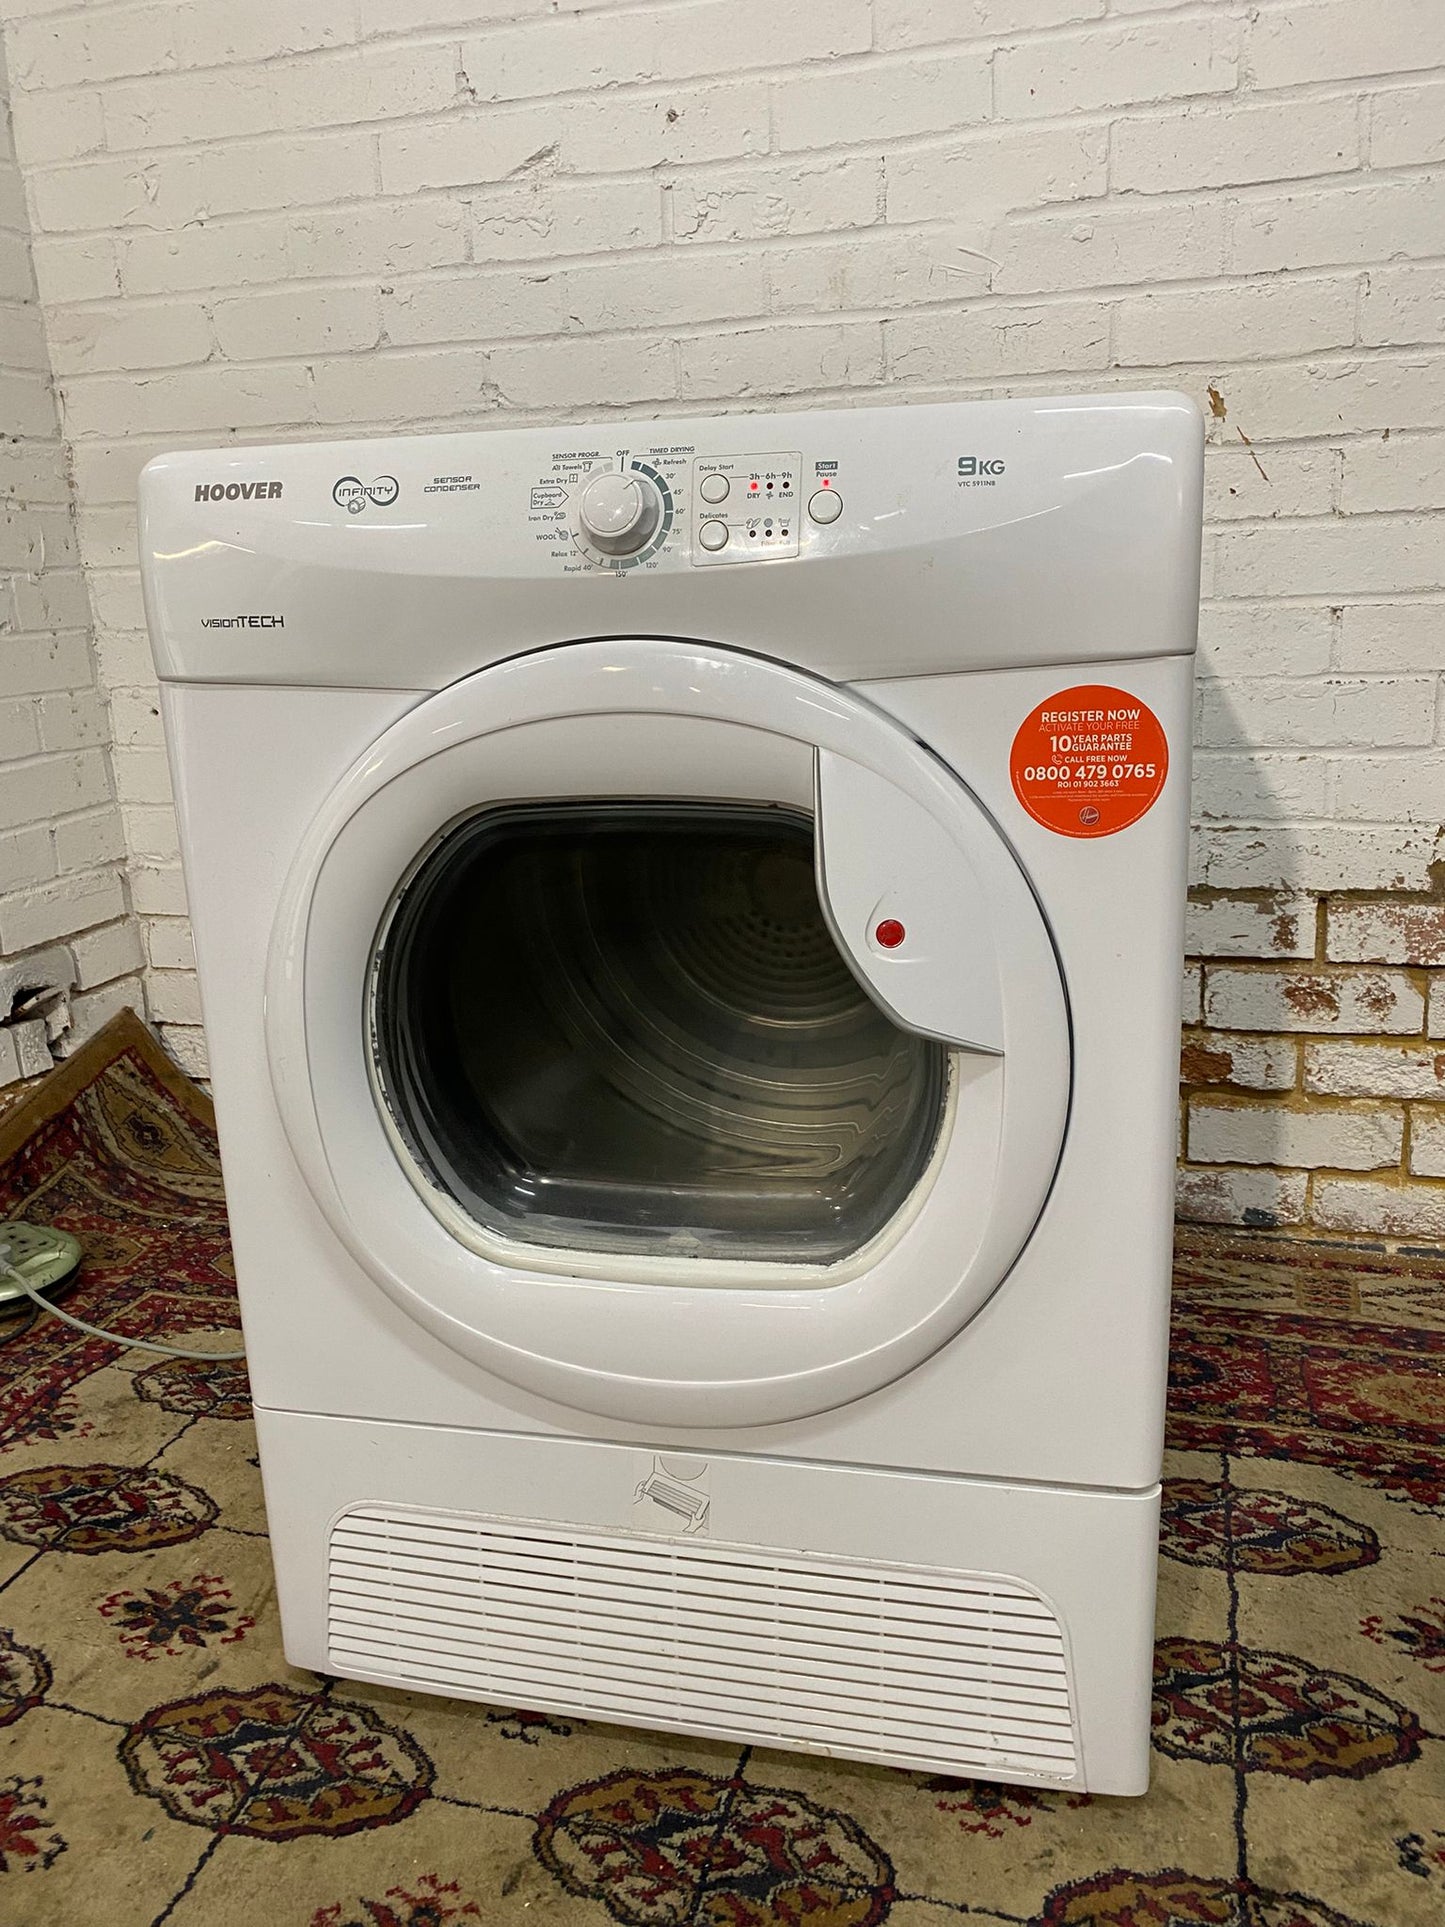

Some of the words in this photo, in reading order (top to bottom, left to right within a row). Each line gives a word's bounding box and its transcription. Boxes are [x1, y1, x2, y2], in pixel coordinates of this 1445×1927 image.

[817, 462, 838, 470] Start
[433, 475, 472, 485] SENSOR
[194, 481, 283, 502] HOOVER
[338, 485, 394, 498] INFINITY
[424, 483, 481, 493] CONDENSER
[533, 491, 562, 499] Cupboard
[778, 491, 794, 499] END
[700, 512, 728, 520] Delicates
[1041, 711, 1104, 723] REGISTER
[1107, 709, 1141, 721] NOW
[1038, 723, 1083, 732] ACTIVATE
[1086, 722, 1113, 731] YOUR
[1116, 720, 1140, 730] FREE
[1050, 735, 1072, 752] 10
[1072, 734, 1099, 743] YEAR
[1100, 733, 1133, 742] PARTS
[1072, 742, 1132, 751] GUARANTEE
[1064, 755, 1084, 763] CALL
[1086, 755, 1106, 763] FREE
[1024, 766, 1071, 781] 0800
[1075, 765, 1108, 780] 479
[1112, 763, 1156, 779] 0765
[1072, 780, 1083, 788] 01
